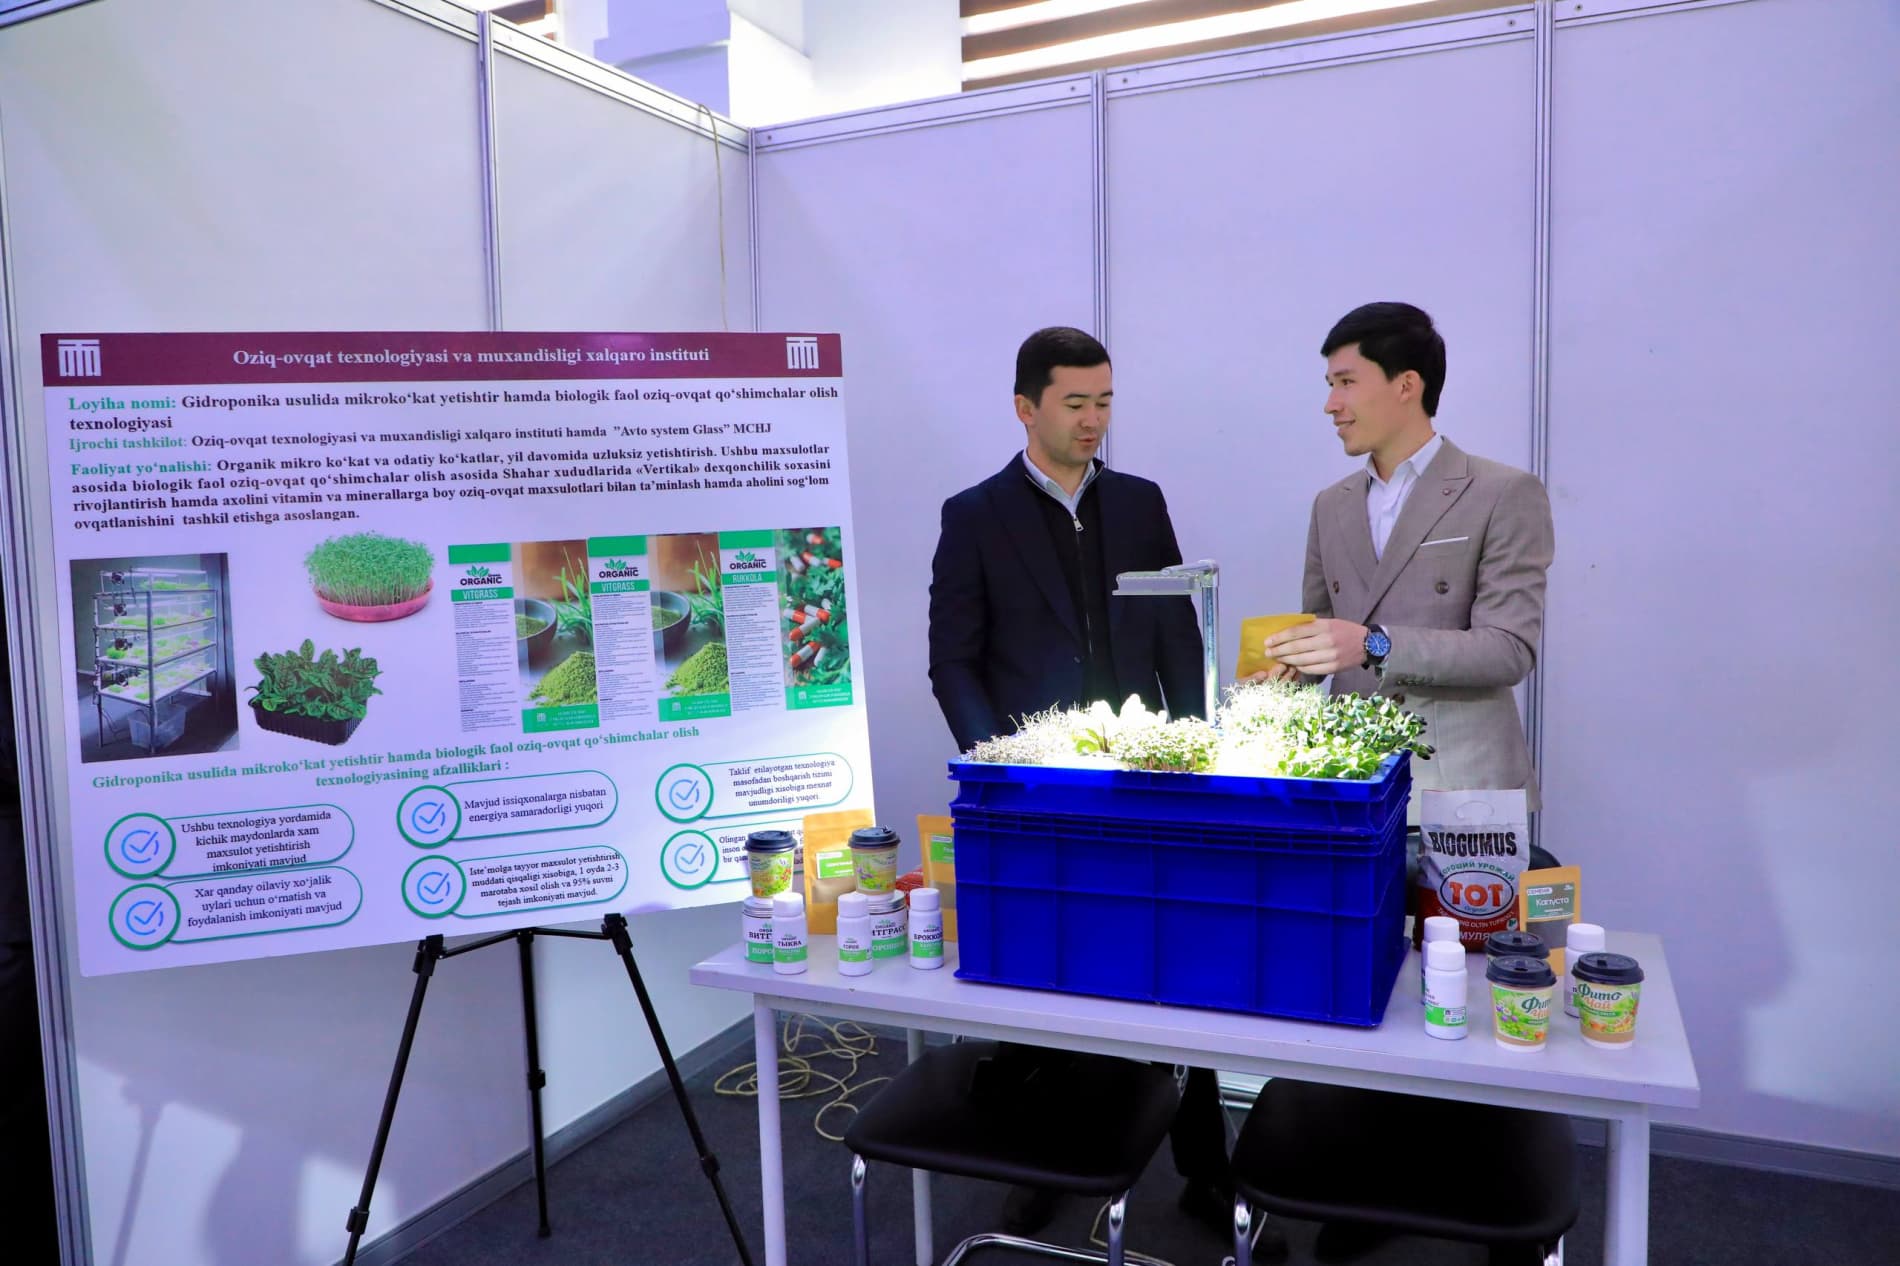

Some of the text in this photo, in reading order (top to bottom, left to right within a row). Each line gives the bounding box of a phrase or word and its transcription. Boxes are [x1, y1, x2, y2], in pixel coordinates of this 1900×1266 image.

[233, 348, 709, 368] Oziq-ovqat texnologiyasi va muxandisligi xalqaro instituti
[69, 397, 124, 411] Loyiha
[131, 396, 175, 409] nomi:
[182, 395, 280, 409] Gidroponika
[286, 393, 339, 406] usulida
[440, 391, 499, 406] yetishtir
[504, 390, 550, 402] hamda
[555, 389, 609, 405] biologik
[614, 388, 639, 401] faol
[643, 388, 711, 403] oziq-ovqat
[810, 387, 838, 399] olish
[69, 416, 172, 433] texnologiyasi
[69, 437, 118, 452] Ijrochi
[123, 435, 187, 449] tashkilot:
[192, 434, 267, 449] Oziq-ovqat
[272, 432, 356, 447] texnologiyasi
[361, 432, 375, 442] va
[379, 428, 460, 444] muxandisligi
[465, 427, 511, 441] xalqaro
[515, 426, 562, 439] instituti
[566, 425, 606, 437] hamda
[651, 424, 688, 437] system
[733, 423, 771, 434] MCHJ
[71, 462, 131, 477] Faoliyat
[217, 457, 275, 473] Organik
[280, 456, 321, 469] mikro
[374, 456, 389, 467] va
[394, 454, 434, 468] odatiy
[507, 450, 524, 464] yil
[528, 450, 588, 462] davomida
[593, 449, 642, 460] uzluksiz
[646, 447, 717, 461] yetishtirish.
[721, 445, 758, 458] Ushbu
[762, 444, 829, 456] maxsulotlar
[72, 480, 127, 495] asosida
[133, 477, 192, 493] biologik
[198, 476, 225, 490] faol
[230, 475, 305, 491] oziq-ovqat
[414, 470, 446, 483] olish
[450, 468, 498, 481] asosida
[503, 466, 549, 479] Shahar
[554, 463, 631, 477] xududlarida
[704, 460, 780, 474] dexqonchilik
[784, 459, 830, 471] soxasini
[74, 496, 166, 513] rivojlantirish
[171, 495, 218, 508] hamda
[223, 494, 268, 506] axolini
[272, 492, 322, 504] vitamin
[326, 493, 341, 503] va
[346, 489, 429, 504] minerallarga
[433, 487, 456, 502] boy
[460, 484, 524, 499] oziq-ovqat
[529, 482, 603, 495] maxsulotlari
[607, 480, 636, 492] bilan
[704, 477, 742, 489] hamda
[746, 475, 784, 487] aholini
[74, 508, 359, 531] ovqatlanishini tashkil etishga asoslangan.
[460, 577, 502, 586] ORGANIC
[599, 569, 638, 578] ORGANIC
[463, 590, 498, 599] VITGRASS
[602, 582, 635, 592] VITGRASS
[92, 771, 183, 789] Gidroponika
[188, 766, 237, 780] usulida
[330, 754, 384, 771] yetishtir
[388, 751, 431, 763] hamda
[436, 745, 486, 759] biologik
[490, 742, 513, 754] faol
[517, 738, 580, 752] oziq-ovqat
[672, 727, 699, 738] olish
[316, 761, 501, 787] texnologiyasining afzalliklari
[733, 772, 810, 786] masofadan boshqarish
[754, 764, 793, 774] etilayotgan
[464, 788, 606, 810] Mavjud issiqxonalarga nisbatan
[181, 811, 331, 833] Ushbu texnologiya yordamida
[469, 802, 603, 823] energiya samaradorligi yuqori
[196, 826, 319, 846] kichik maydonlarda xam
[1428, 832, 1516, 857] BIOGUMUS
[207, 841, 310, 859] maxsulot yetishtirish
[212, 855, 306, 872] imkoniyati mavjud
[514, 852, 620, 872] tayyor maxsulot yetishtirish
[1442, 862, 1515, 881] ОРОШИЙ УРОЖАЙ
[194, 888, 214, 899] Xar
[217, 884, 253, 896] qanday
[256, 880, 290, 892] oilaviy
[472, 876, 504, 887] muddati
[507, 872, 540, 884] qisqaligi
[481, 882, 559, 897] marotaba xosil olish
[202, 900, 232, 911] uylari
[234, 898, 264, 909] uchun
[498, 893, 564, 907] tejash imkoniyati
[188, 902, 342, 928] foydalanish imkoniyati mavjud
